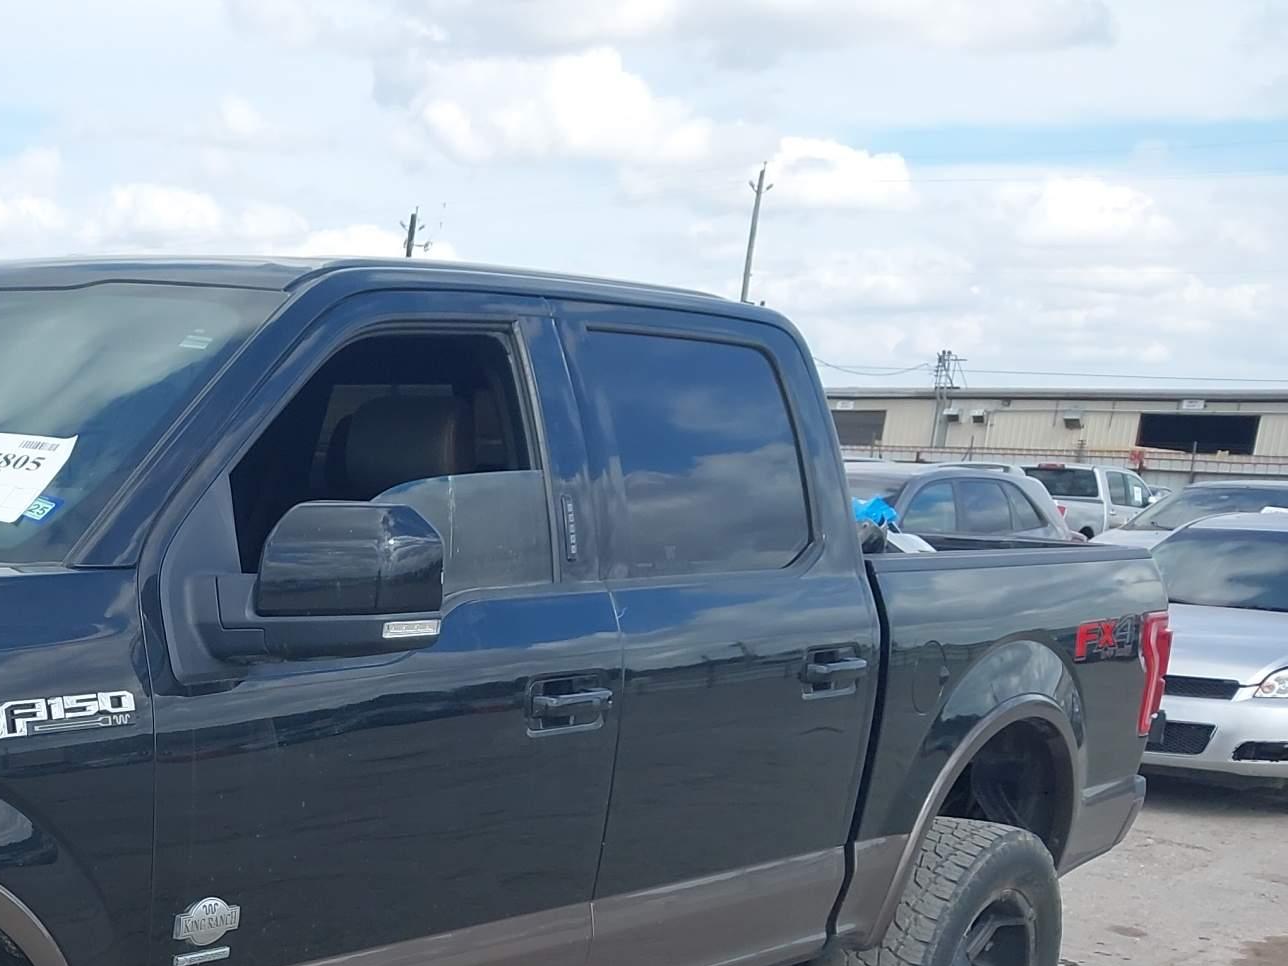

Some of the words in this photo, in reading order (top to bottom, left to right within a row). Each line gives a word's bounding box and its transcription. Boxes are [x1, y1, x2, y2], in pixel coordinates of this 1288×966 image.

[29, 503, 50, 516] 25
[1074, 614, 1136, 661] FX4
[184, 917, 205, 934] KING
[206, 911, 237, 929] RANCH
